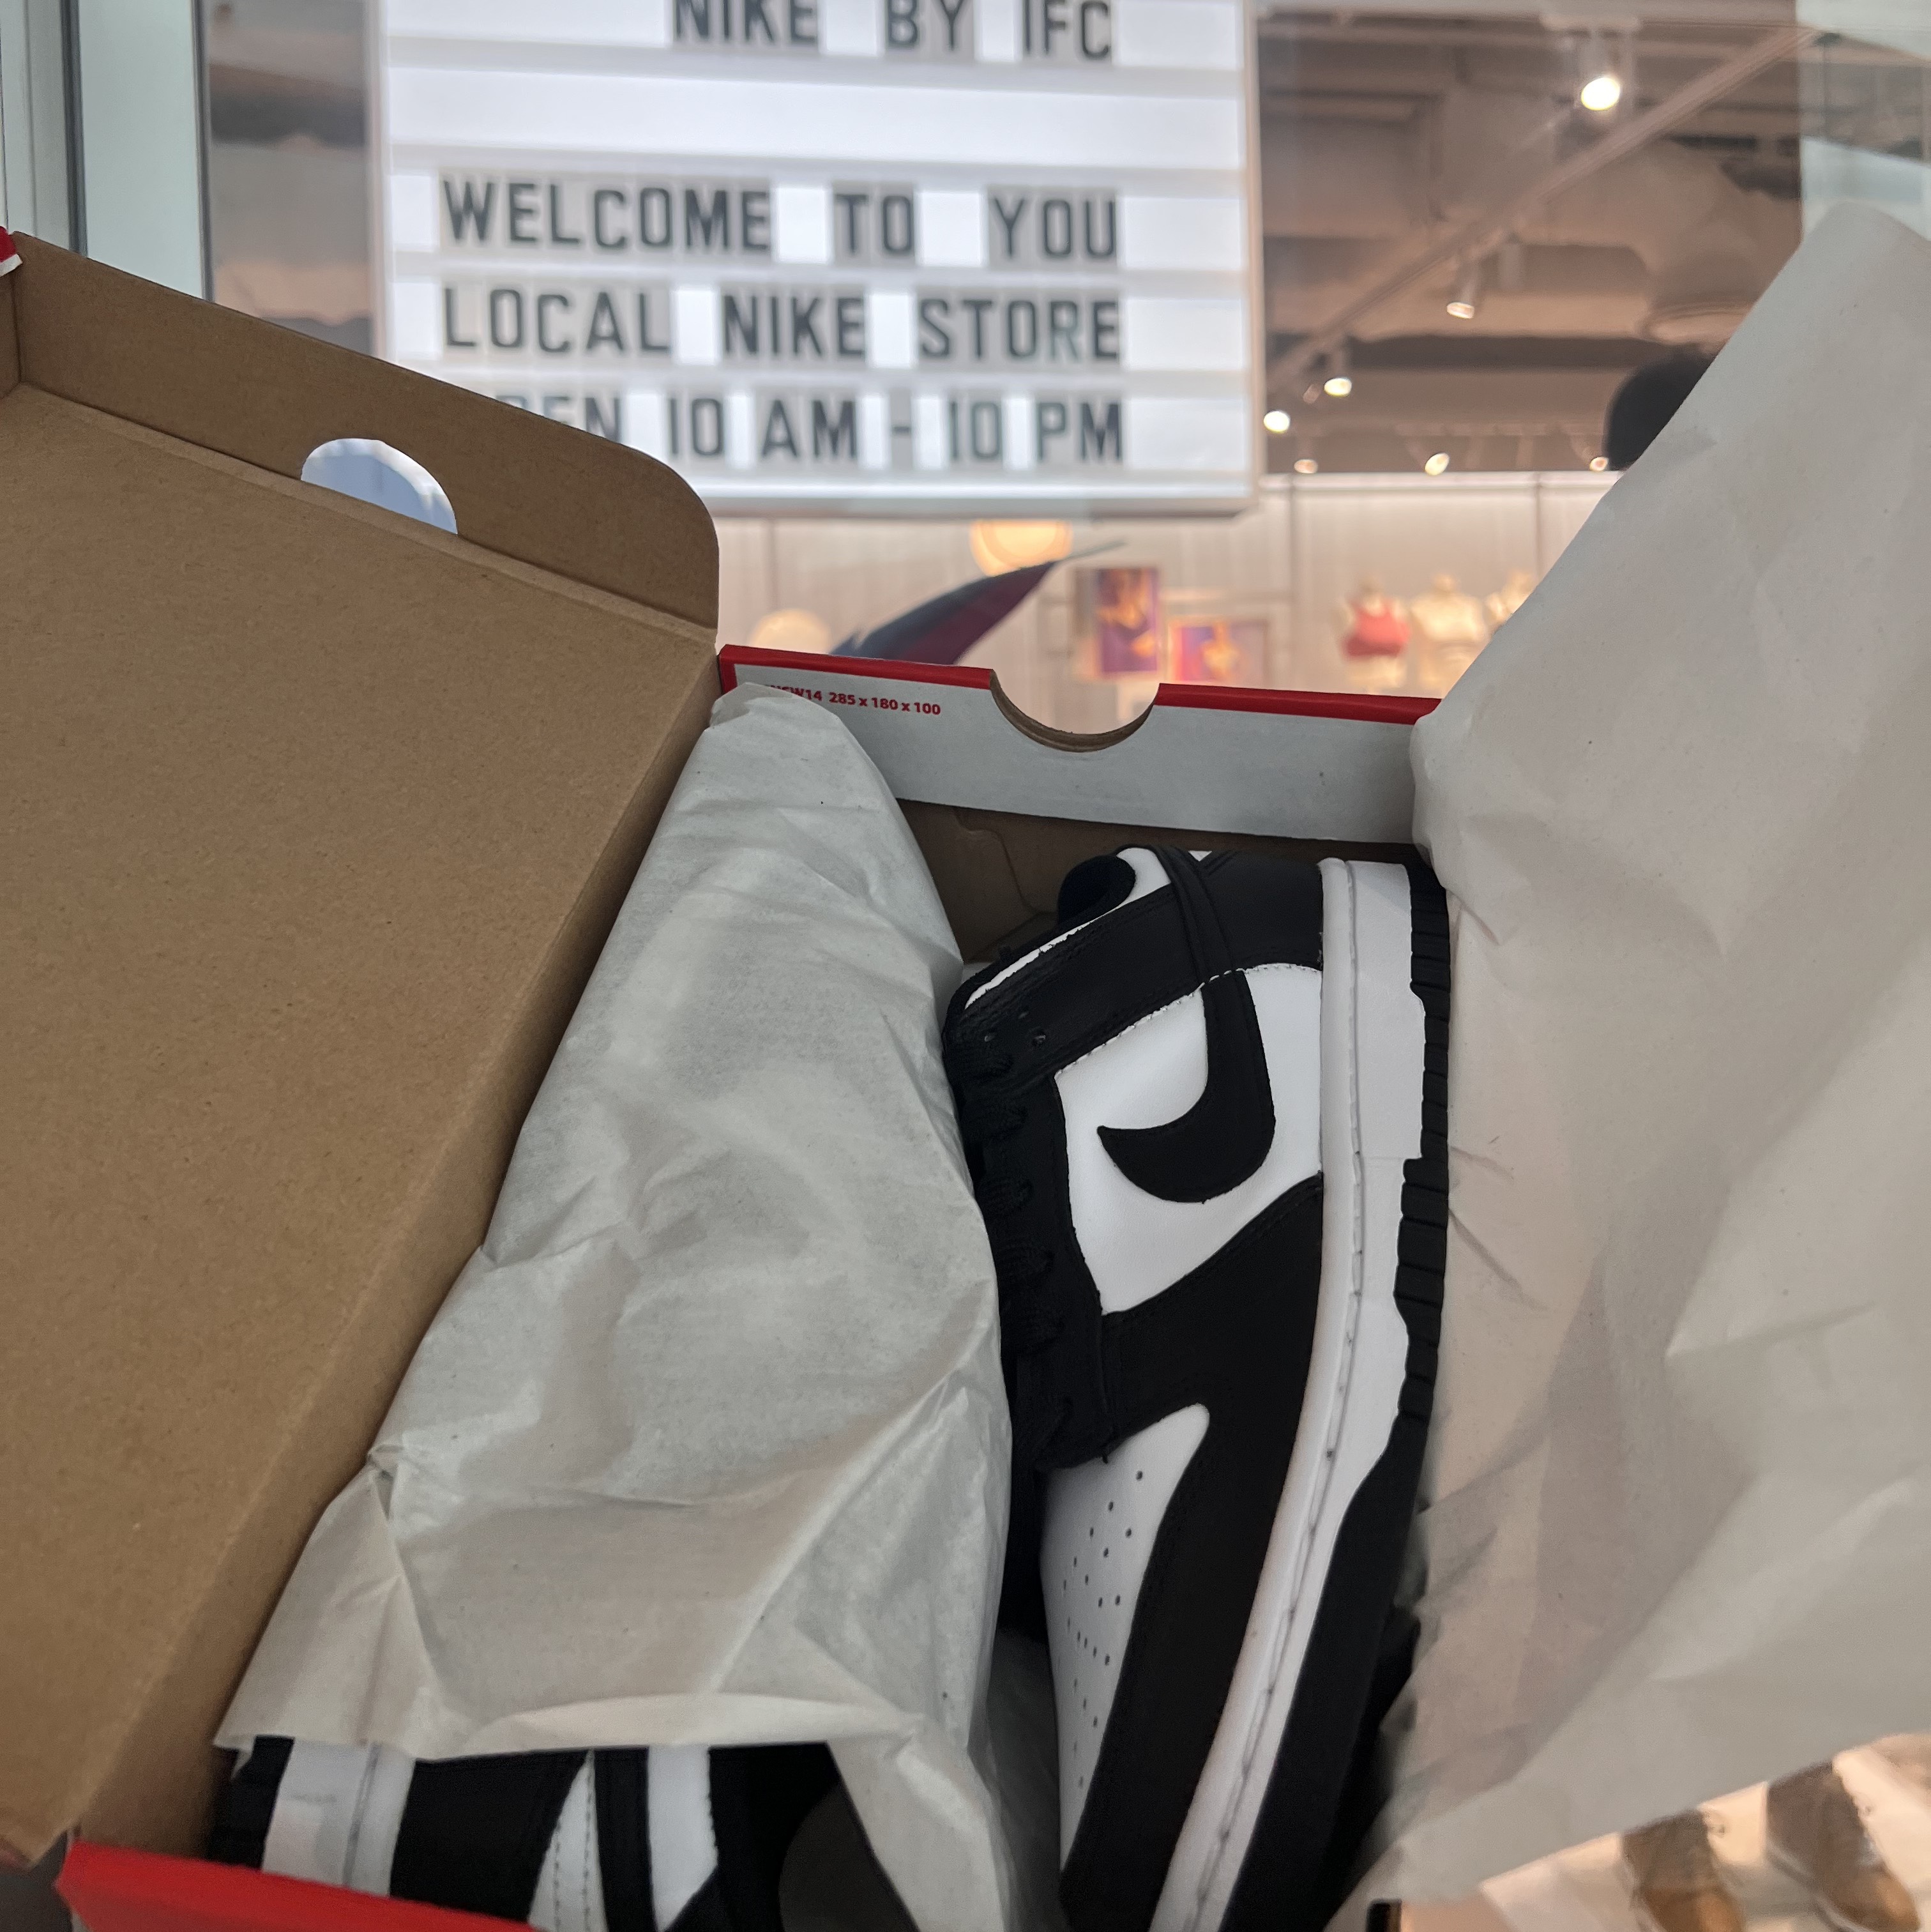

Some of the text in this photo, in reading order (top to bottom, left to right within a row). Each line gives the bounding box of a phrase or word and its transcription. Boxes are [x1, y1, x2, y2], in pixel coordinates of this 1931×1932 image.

[676, 0, 1111, 59] NIKE BY IFC
[443, 179, 1116, 259] WELCOME TO YOU
[444, 287, 1118, 360] LOCAL NIKE STORE
[761, 399, 856, 459] AM
[1038, 402, 1123, 462] PM
[770, 684, 941, 715] W14 285 x 180 x 100
